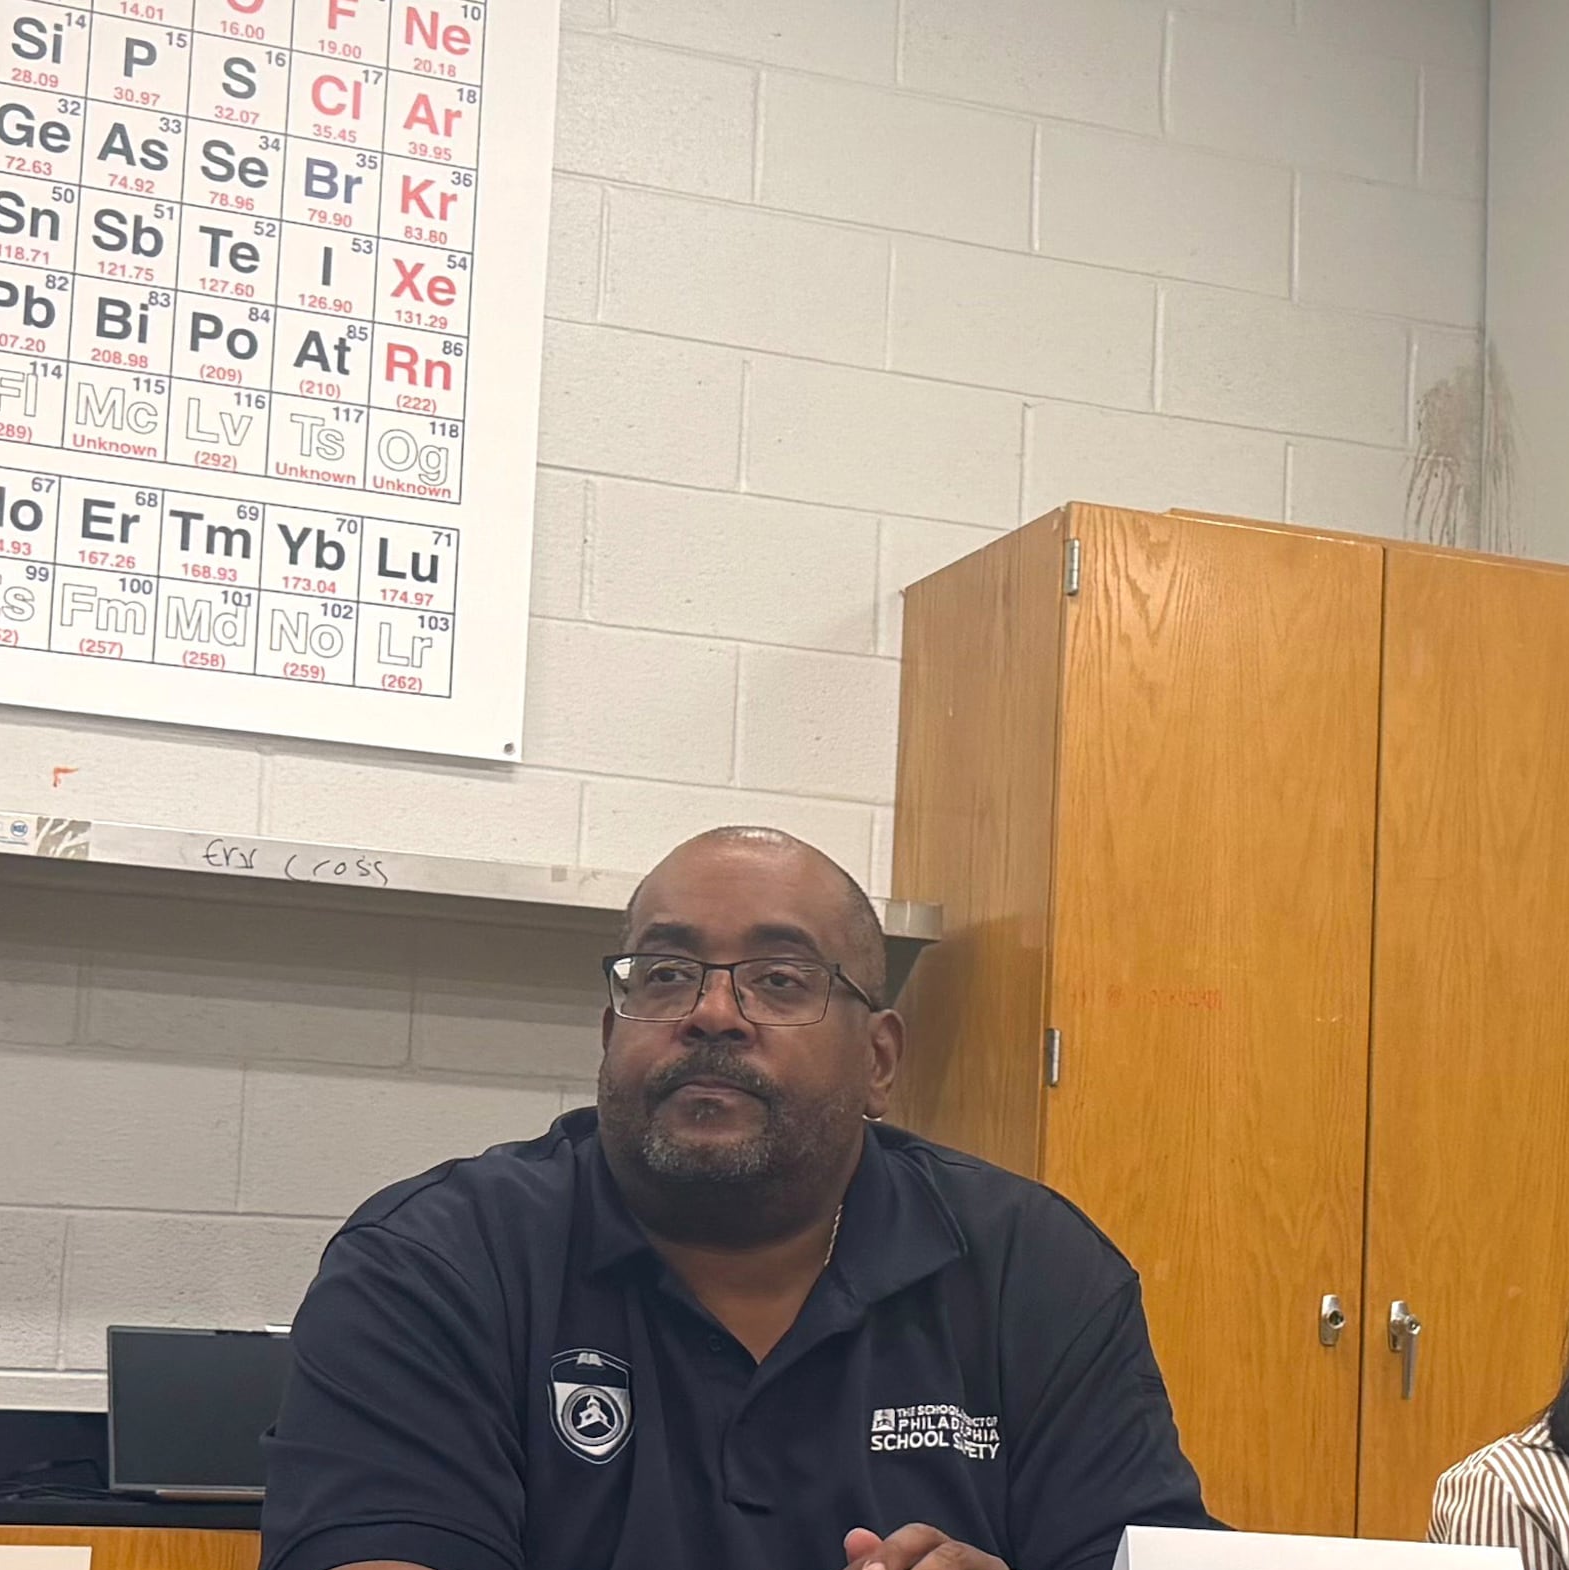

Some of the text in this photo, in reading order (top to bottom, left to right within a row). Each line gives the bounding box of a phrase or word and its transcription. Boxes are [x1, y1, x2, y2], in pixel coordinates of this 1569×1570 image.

[12, 17, 62, 64] Si
[166, 32, 187, 48] 15
[405, 7, 471, 56] Ne
[12, 70, 60, 88] 28.09
[124, 37, 156, 77] P
[222, 57, 256, 99] S
[266, 51, 285, 67] 16
[312, 76, 362, 120] Cl
[404, 94, 462, 137] Ar
[97, 123, 168, 171] As
[201, 140, 268, 188] Se
[52, 186, 74, 203] 50
[210, 193, 254, 210] 78.96
[305, 158, 362, 203] Br
[401, 176, 458, 221] Kr
[92, 209, 163, 257] Sb
[154, 204, 173, 220] 51
[199, 226, 260, 273] Te
[392, 259, 456, 307] Xe
[190, 312, 258, 360] Po
[293, 330, 351, 375] At
[385, 343, 452, 391] Rn
[186, 398, 253, 446] Lv
[430, 422, 459, 438] 118
[71, 434, 157, 456] Unknown
[81, 498, 140, 543] Er
[169, 509, 251, 559] Tm
[433, 531, 451, 547] 71
[277, 524, 345, 571] Yb
[378, 537, 438, 583] Lu
[321, 603, 353, 619] 102
[381, 589, 434, 606] 174.97
[378, 622, 432, 668] Lr
[870, 1431, 950, 1451] SCHOOL
